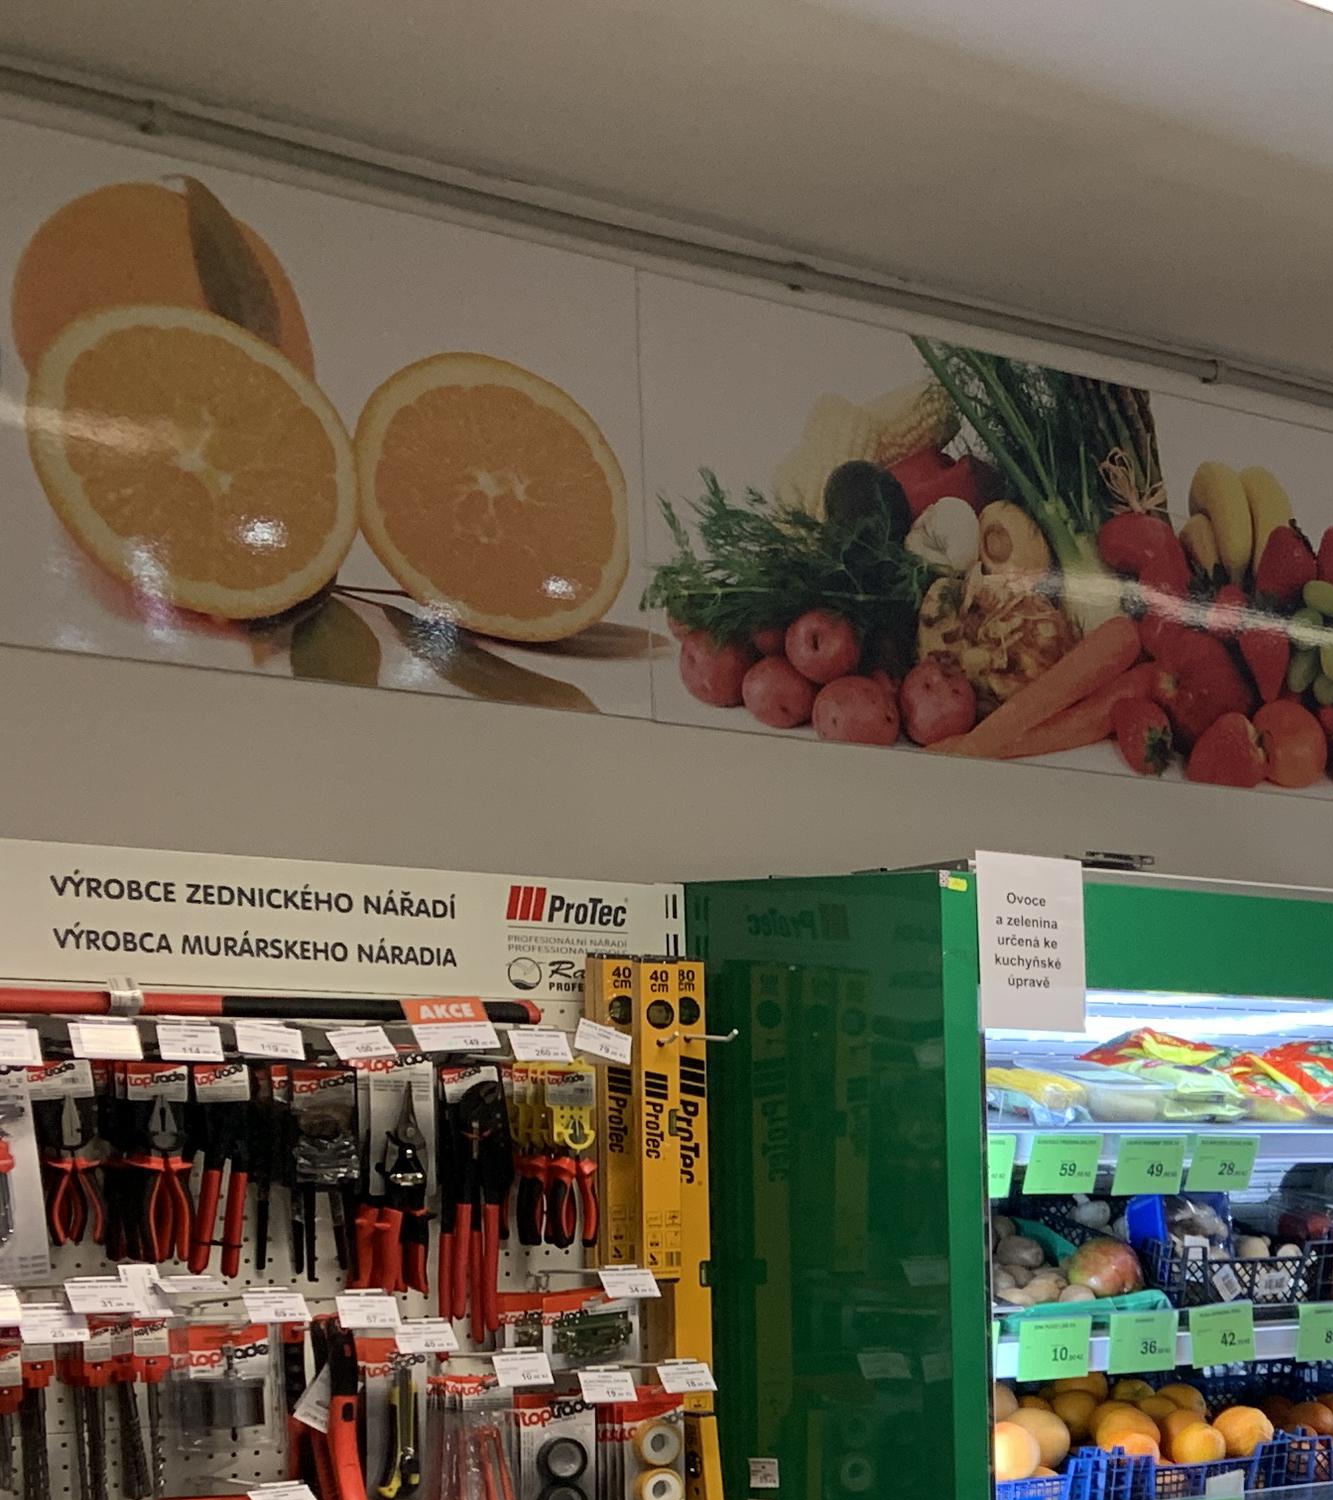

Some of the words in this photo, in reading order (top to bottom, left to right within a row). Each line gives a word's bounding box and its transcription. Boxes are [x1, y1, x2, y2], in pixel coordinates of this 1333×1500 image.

[50, 869, 176, 903] VÝROBCE
[185, 883, 353, 914] ZEDNICKÉHO
[363, 891, 457, 920] NÁŘADÍ
[1006, 892, 1047, 907] Ovoce
[548, 895, 627, 927] ProTec
[995, 916, 1003, 925] a
[1006, 915, 1058, 930] zelenina
[52, 922, 172, 955] VÝROBCA
[181, 930, 348, 963] MURÁRSKEHO
[357, 938, 457, 967] NÁRADIA
[997, 934, 1040, 949] určená
[1043, 938, 1058, 949] ke
[994, 954, 1062, 970] kuchyňské
[612, 967, 632, 979] 40
[650, 970, 669, 982] 40
[650, 983, 669, 992] cm
[1008, 974, 1050, 989] úpravě
[419, 1002, 475, 1020] AKCE
[645, 1101, 665, 1160] ProTec
[1058, 1162, 1077, 1177] 59
[1146, 1163, 1163, 1177] 49
[1218, 1162, 1235, 1176] 28
[1220, 1332, 1236, 1346] 42
[1051, 1347, 1069, 1362] 10
[1140, 1341, 1157, 1354] 36
